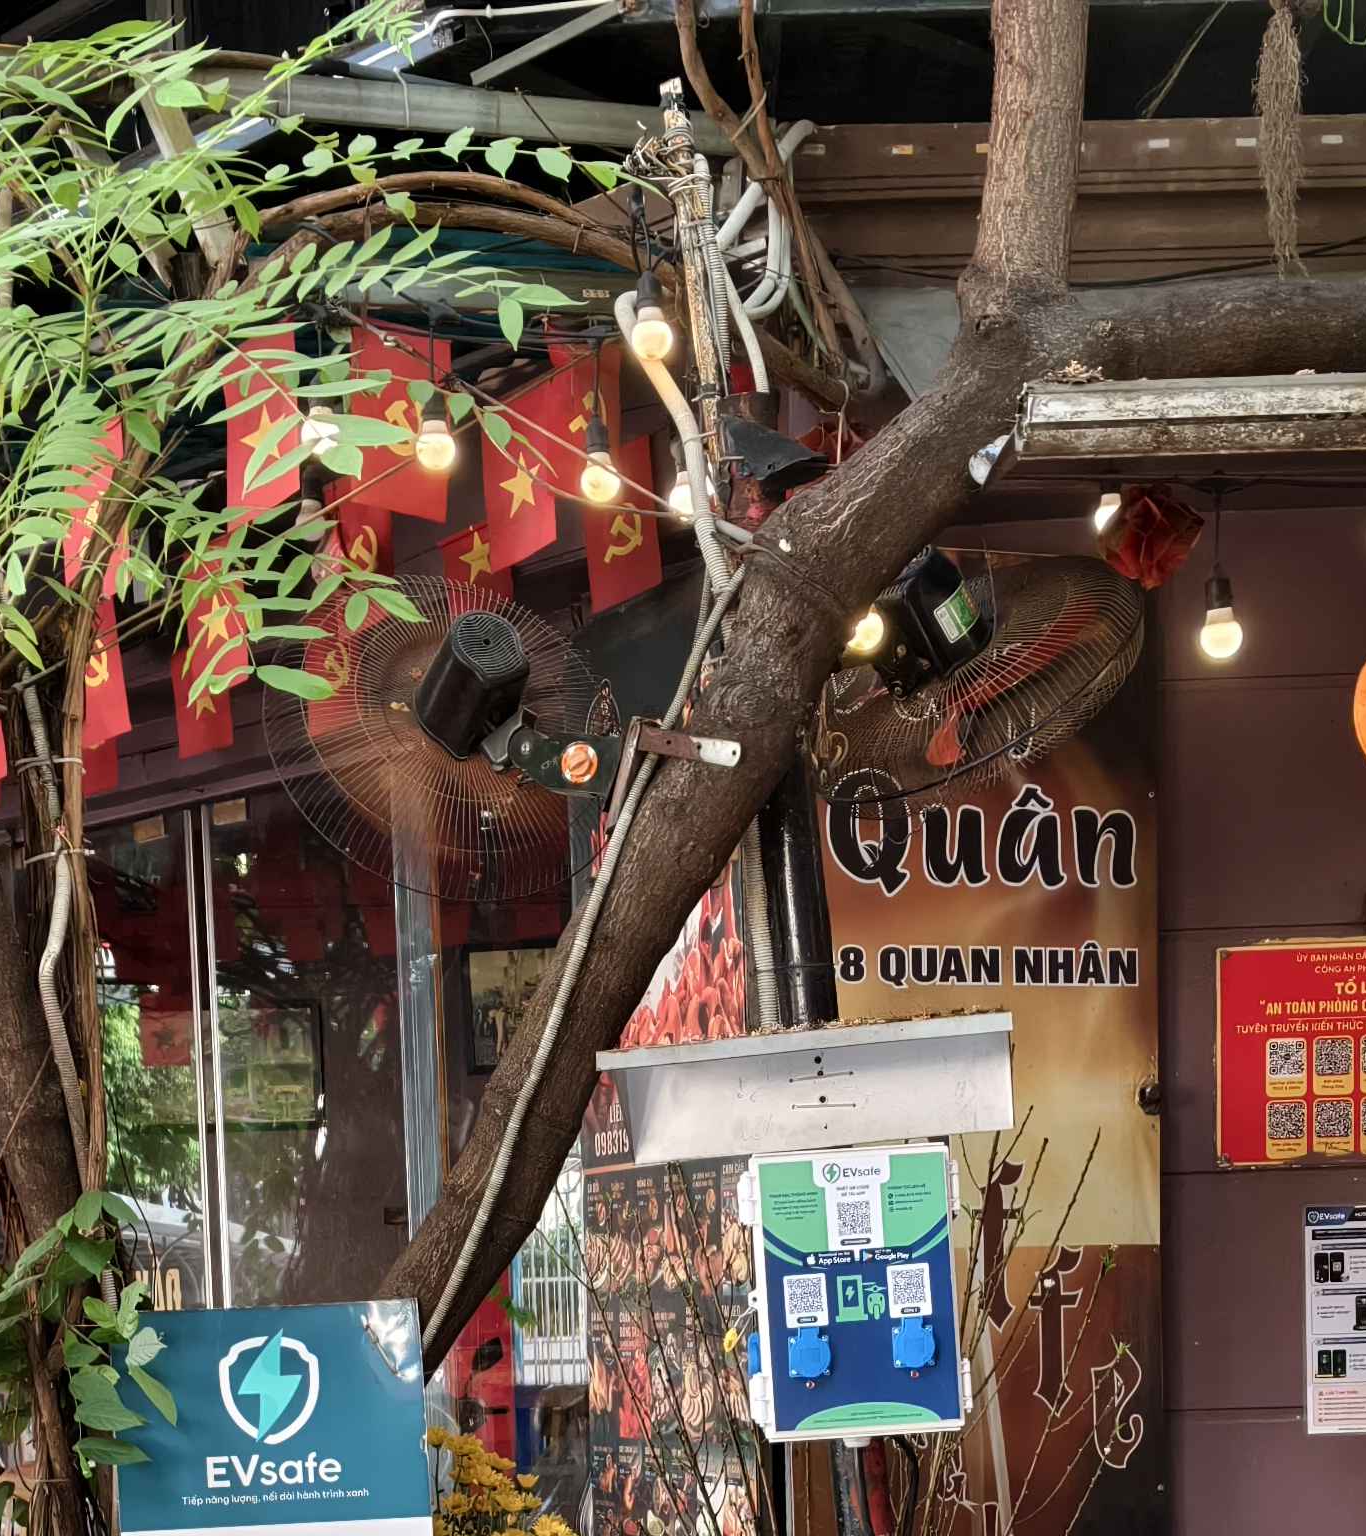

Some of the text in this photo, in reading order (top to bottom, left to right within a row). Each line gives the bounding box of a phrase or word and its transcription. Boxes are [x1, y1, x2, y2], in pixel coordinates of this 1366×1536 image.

[826, 767, 1137, 896] Quân
[1310, 953, 1327, 962] BAN
[1329, 951, 1354, 961] NHÂN
[835, 940, 1139, 989] 8 QUAN NHÂN
[1314, 964, 1341, 974] CÔNG
[1343, 964, 1356, 973] AN
[1318, 998, 1358, 1013] PHÒNG
[842, 1167, 881, 1178] EVsafe
[818, 1255, 851, 1265] App Store
[874, 1252, 910, 1261] Google Play
[205, 1452, 343, 1489] EVsafe
[181, 1494, 204, 1507] Tiếp
[296, 1488, 321, 1500] hành
[322, 1487, 345, 1499] trình
[346, 1487, 370, 1498] xanh
